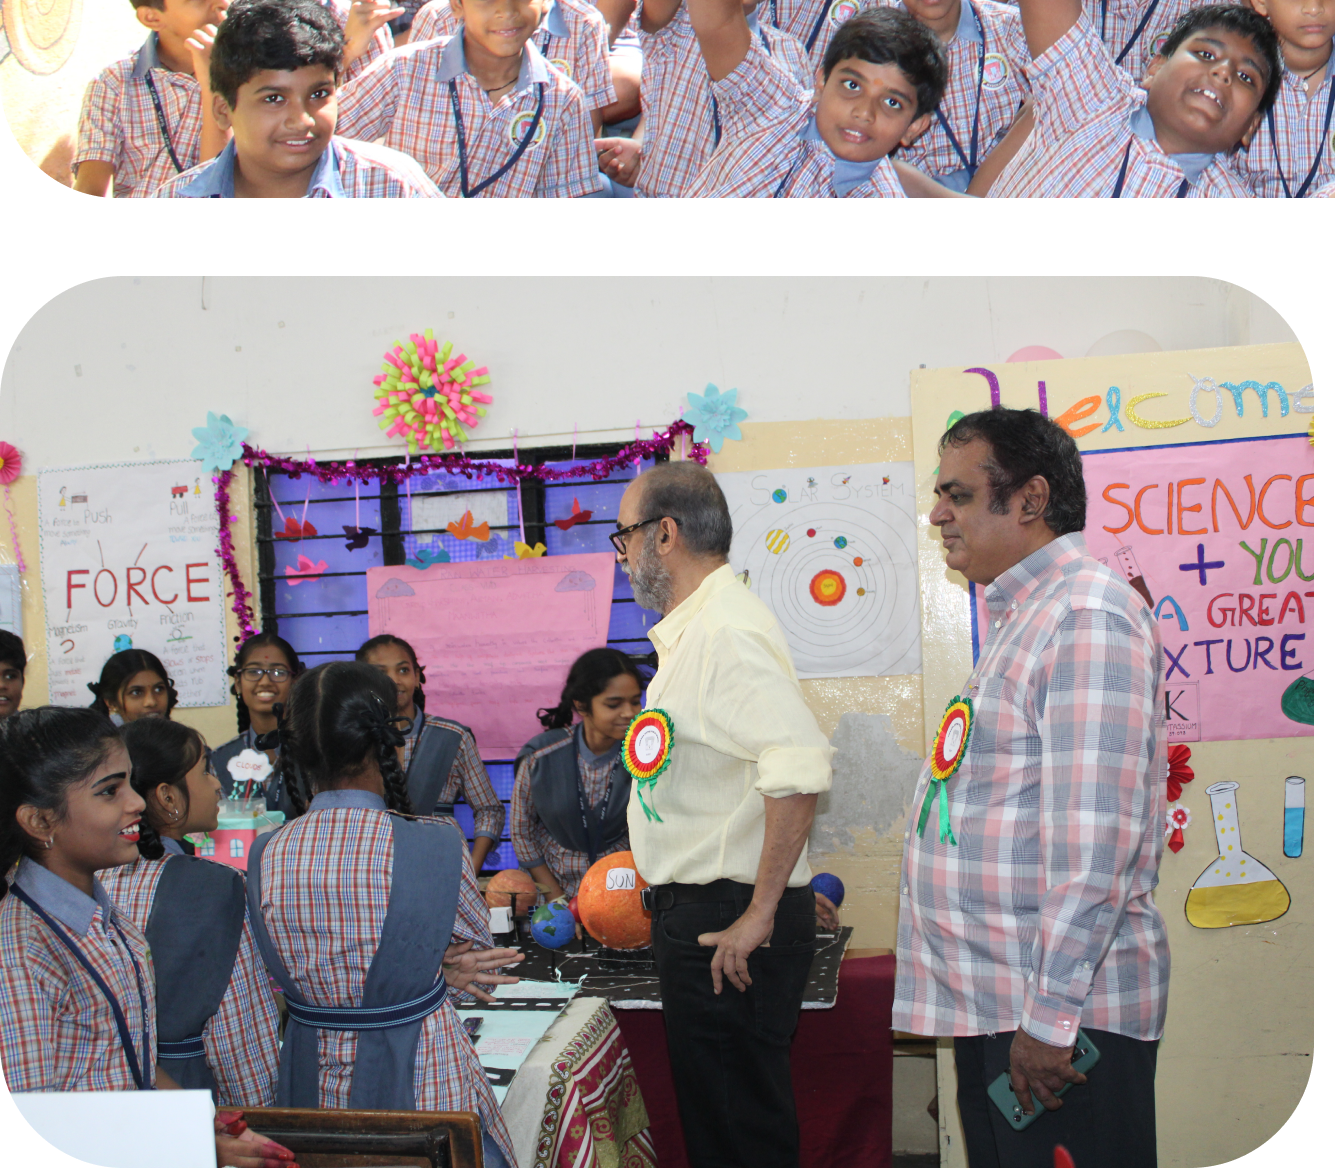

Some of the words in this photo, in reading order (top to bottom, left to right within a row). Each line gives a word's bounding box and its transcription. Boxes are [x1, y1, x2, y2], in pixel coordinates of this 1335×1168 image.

[831, 472, 904, 501] SYSTEM
[1102, 473, 1314, 536] SCIENCE
[67, 562, 210, 609] FORCE
[107, 618, 139, 631] Gravity
[1154, 595, 1189, 631] A
[1207, 591, 1314, 628] GREA
[1163, 633, 1306, 681] XTURE
[1165, 690, 1189, 721] K
[1166, 722, 1197, 732] TASSIUM
[606, 869, 635, 889] SUN
